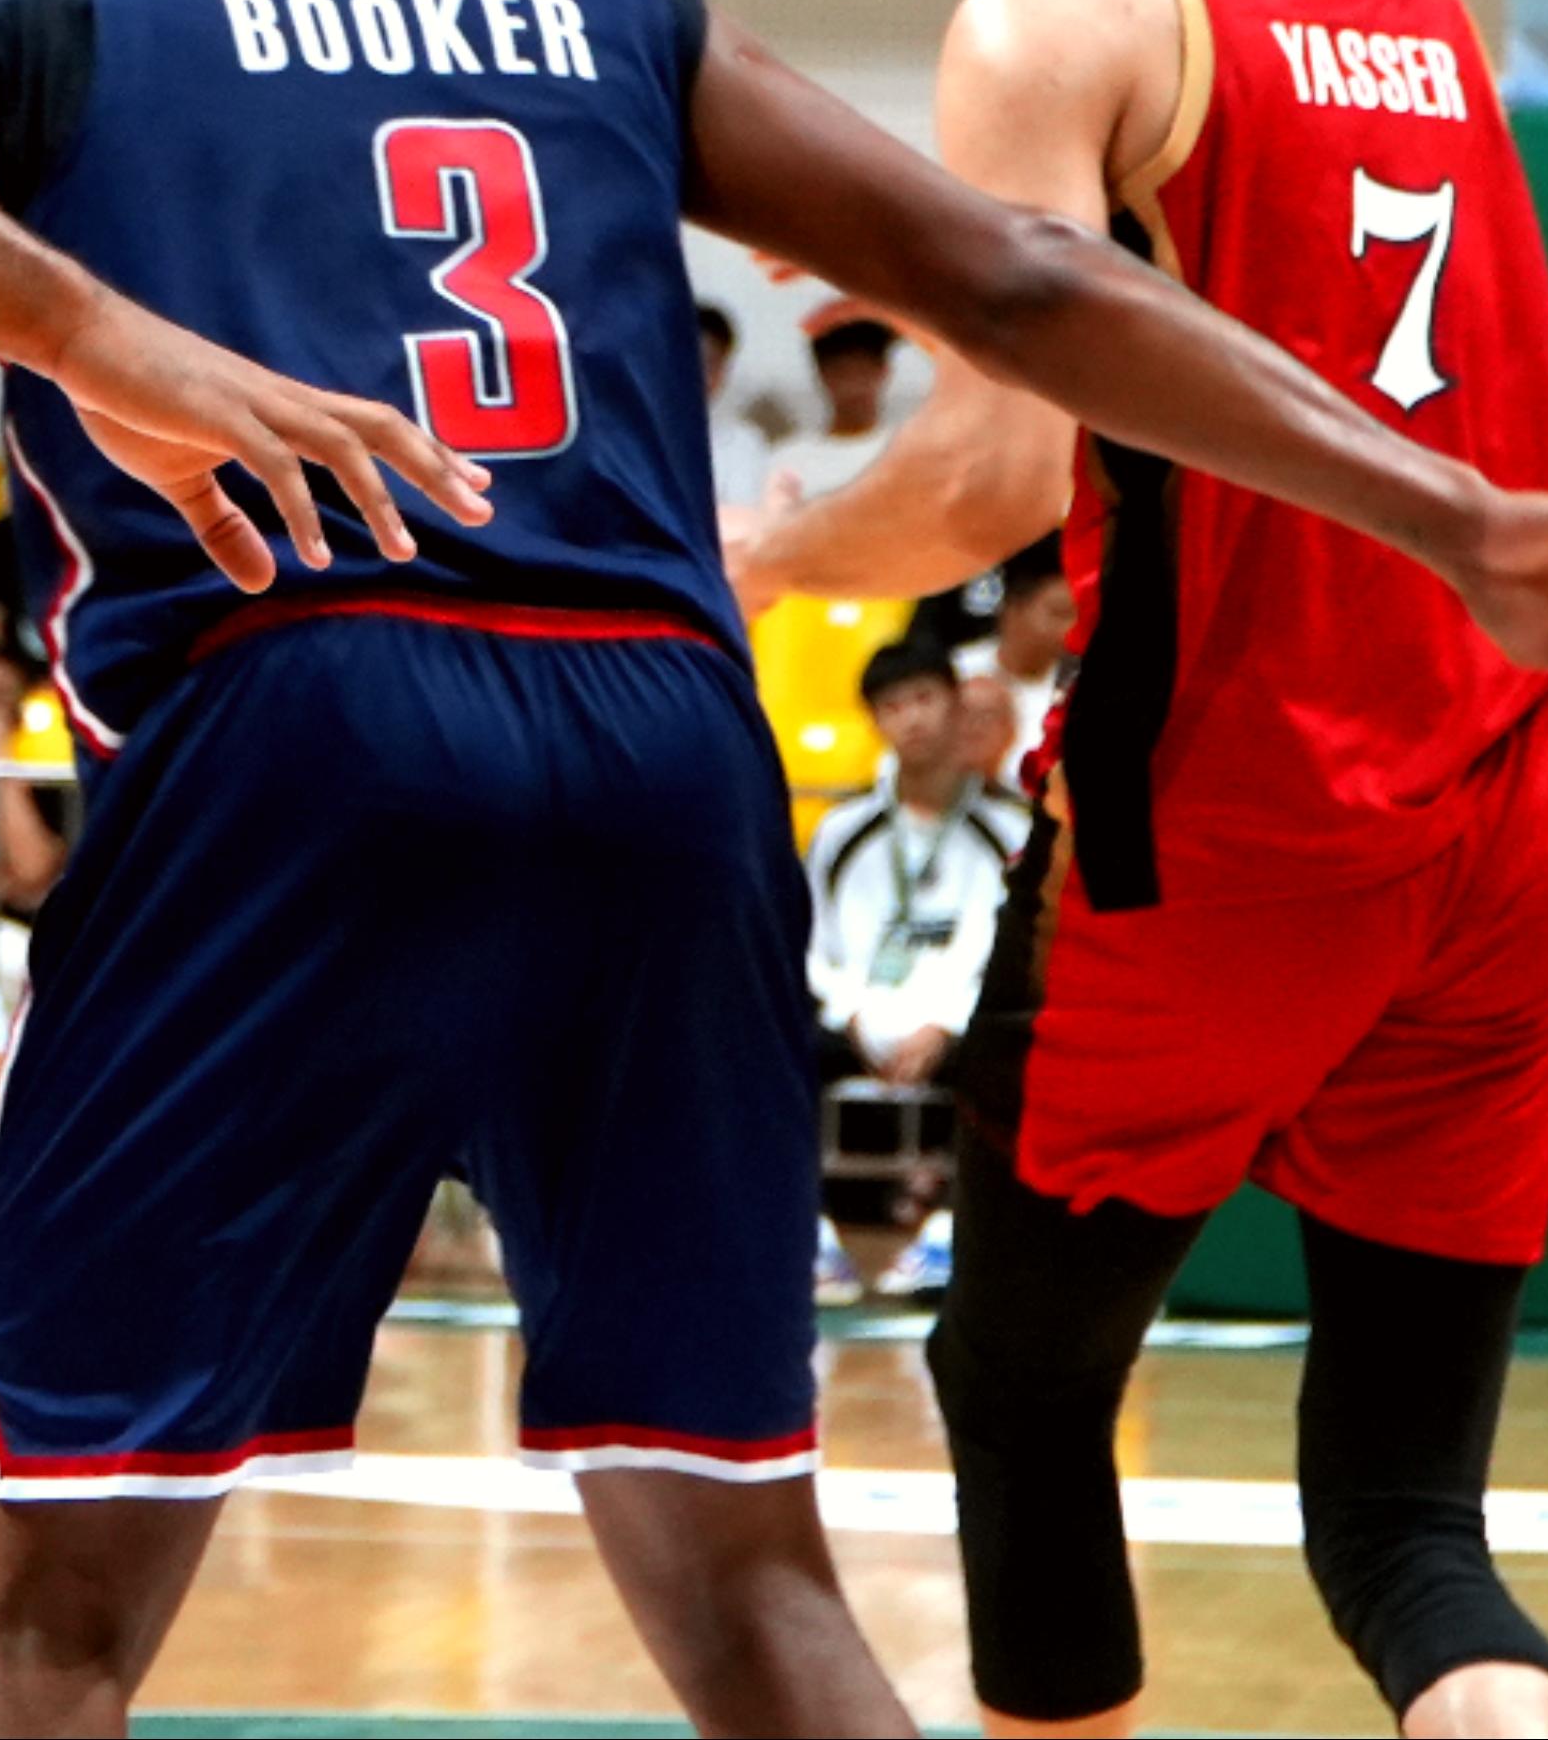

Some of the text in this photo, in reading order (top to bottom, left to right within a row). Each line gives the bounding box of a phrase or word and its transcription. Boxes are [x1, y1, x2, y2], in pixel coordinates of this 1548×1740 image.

[1270, 21, 1466, 122] YASSER
[372, 117, 580, 460] 3
[1350, 166, 1457, 414] 7
